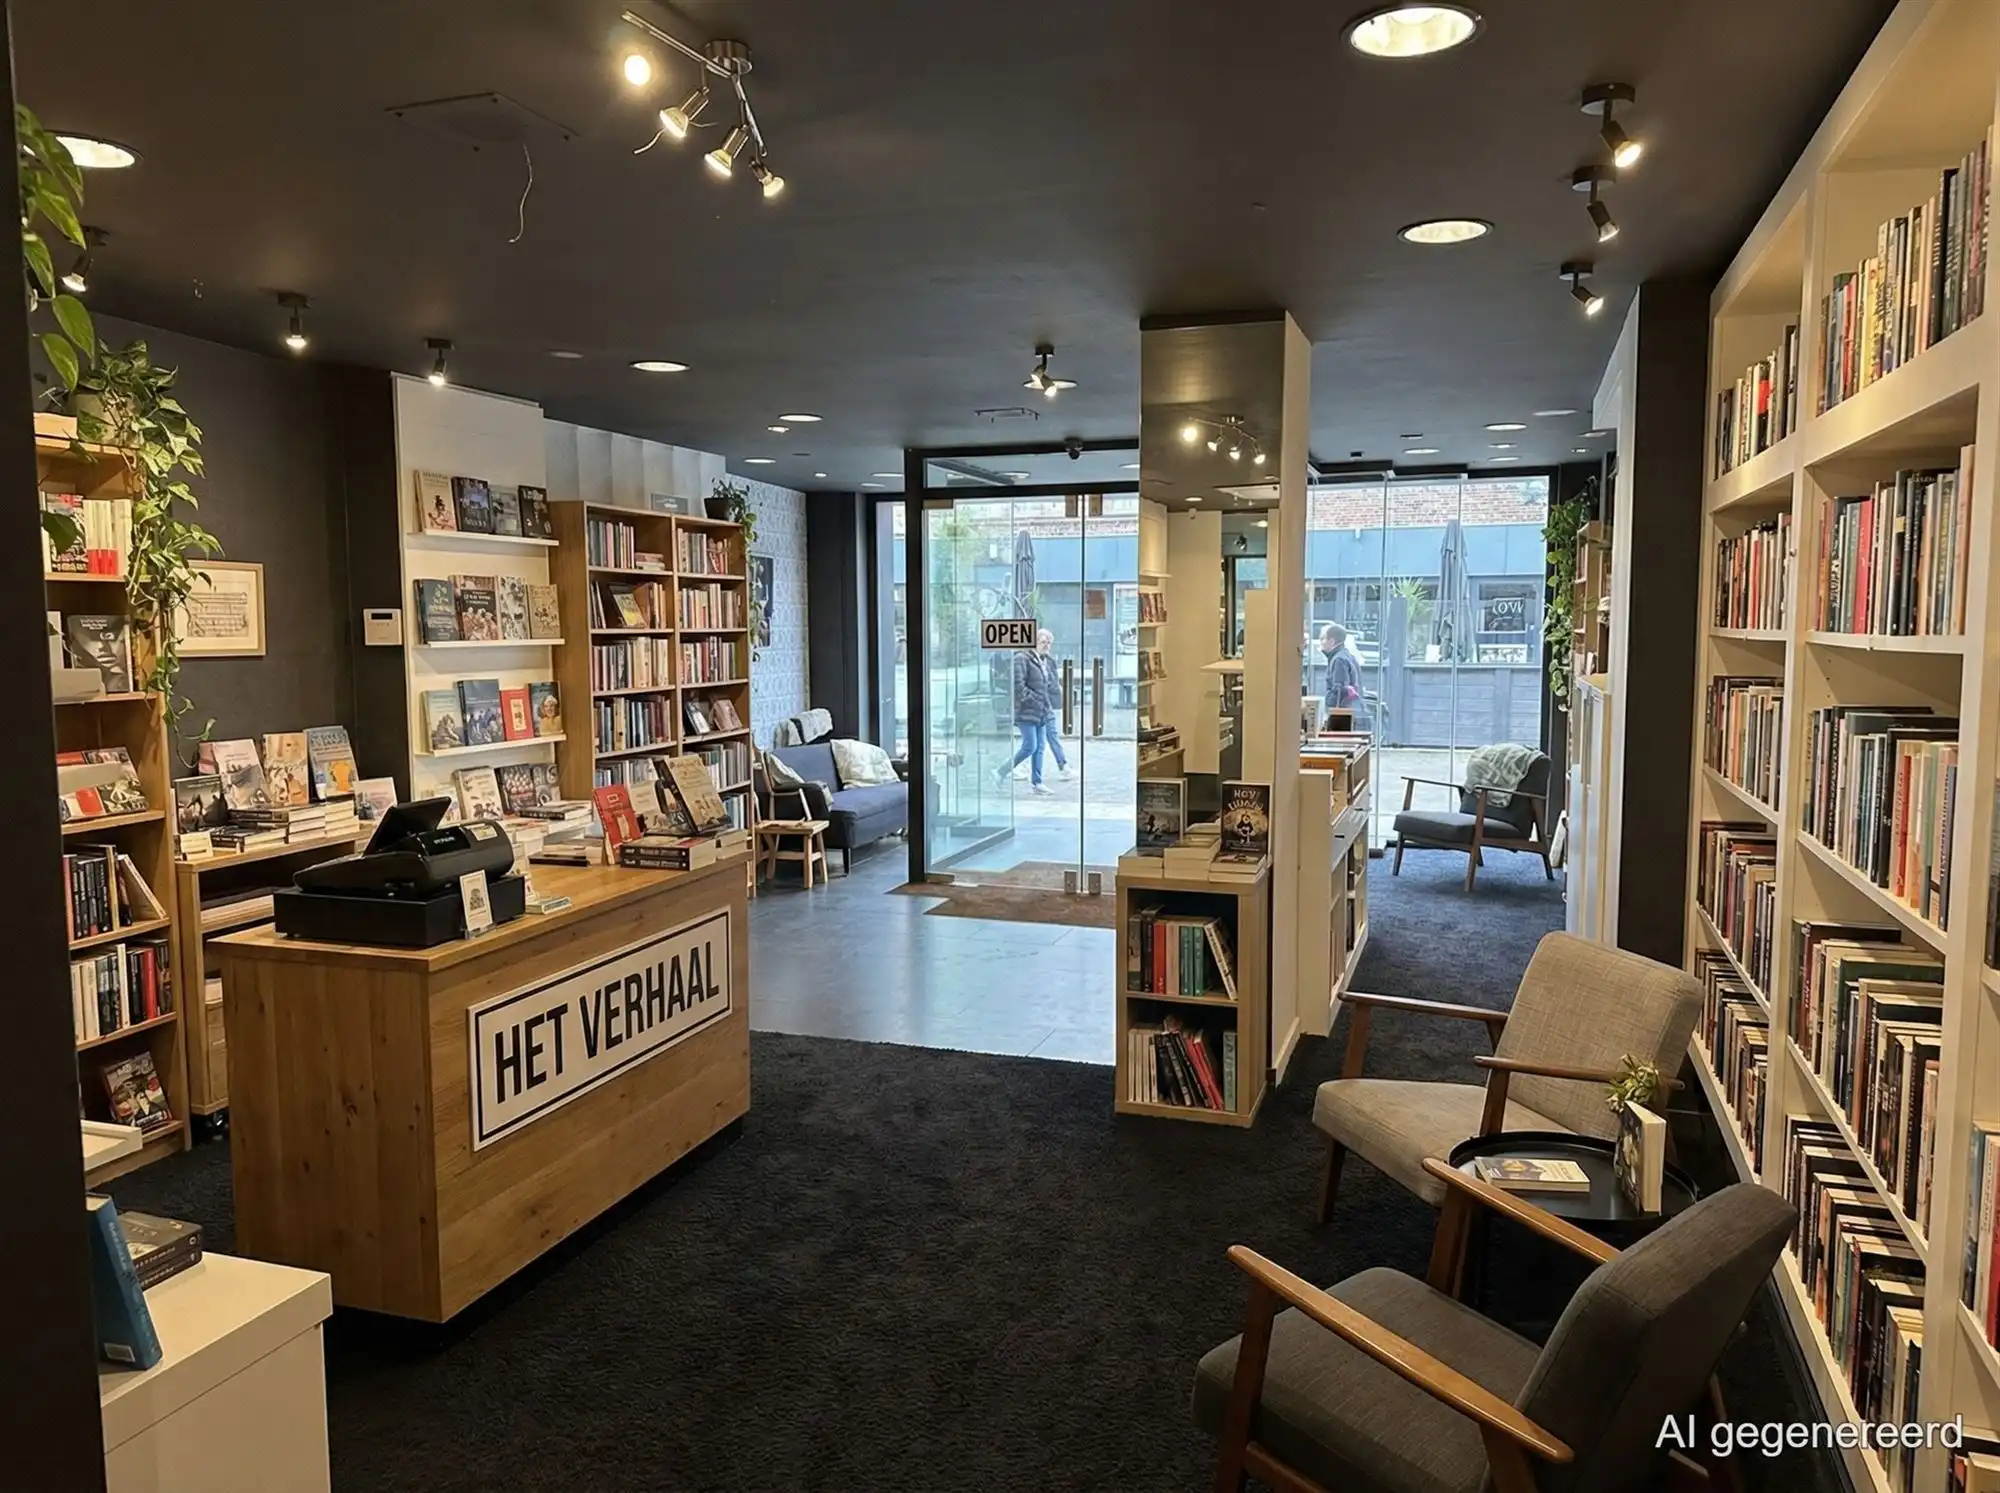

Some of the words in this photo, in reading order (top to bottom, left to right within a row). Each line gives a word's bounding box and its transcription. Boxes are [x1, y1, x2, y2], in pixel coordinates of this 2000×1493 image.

[985, 623, 1032, 644] OPEN
[494, 1003, 568, 1105] HET
[579, 941, 720, 1060] VERHAAL
